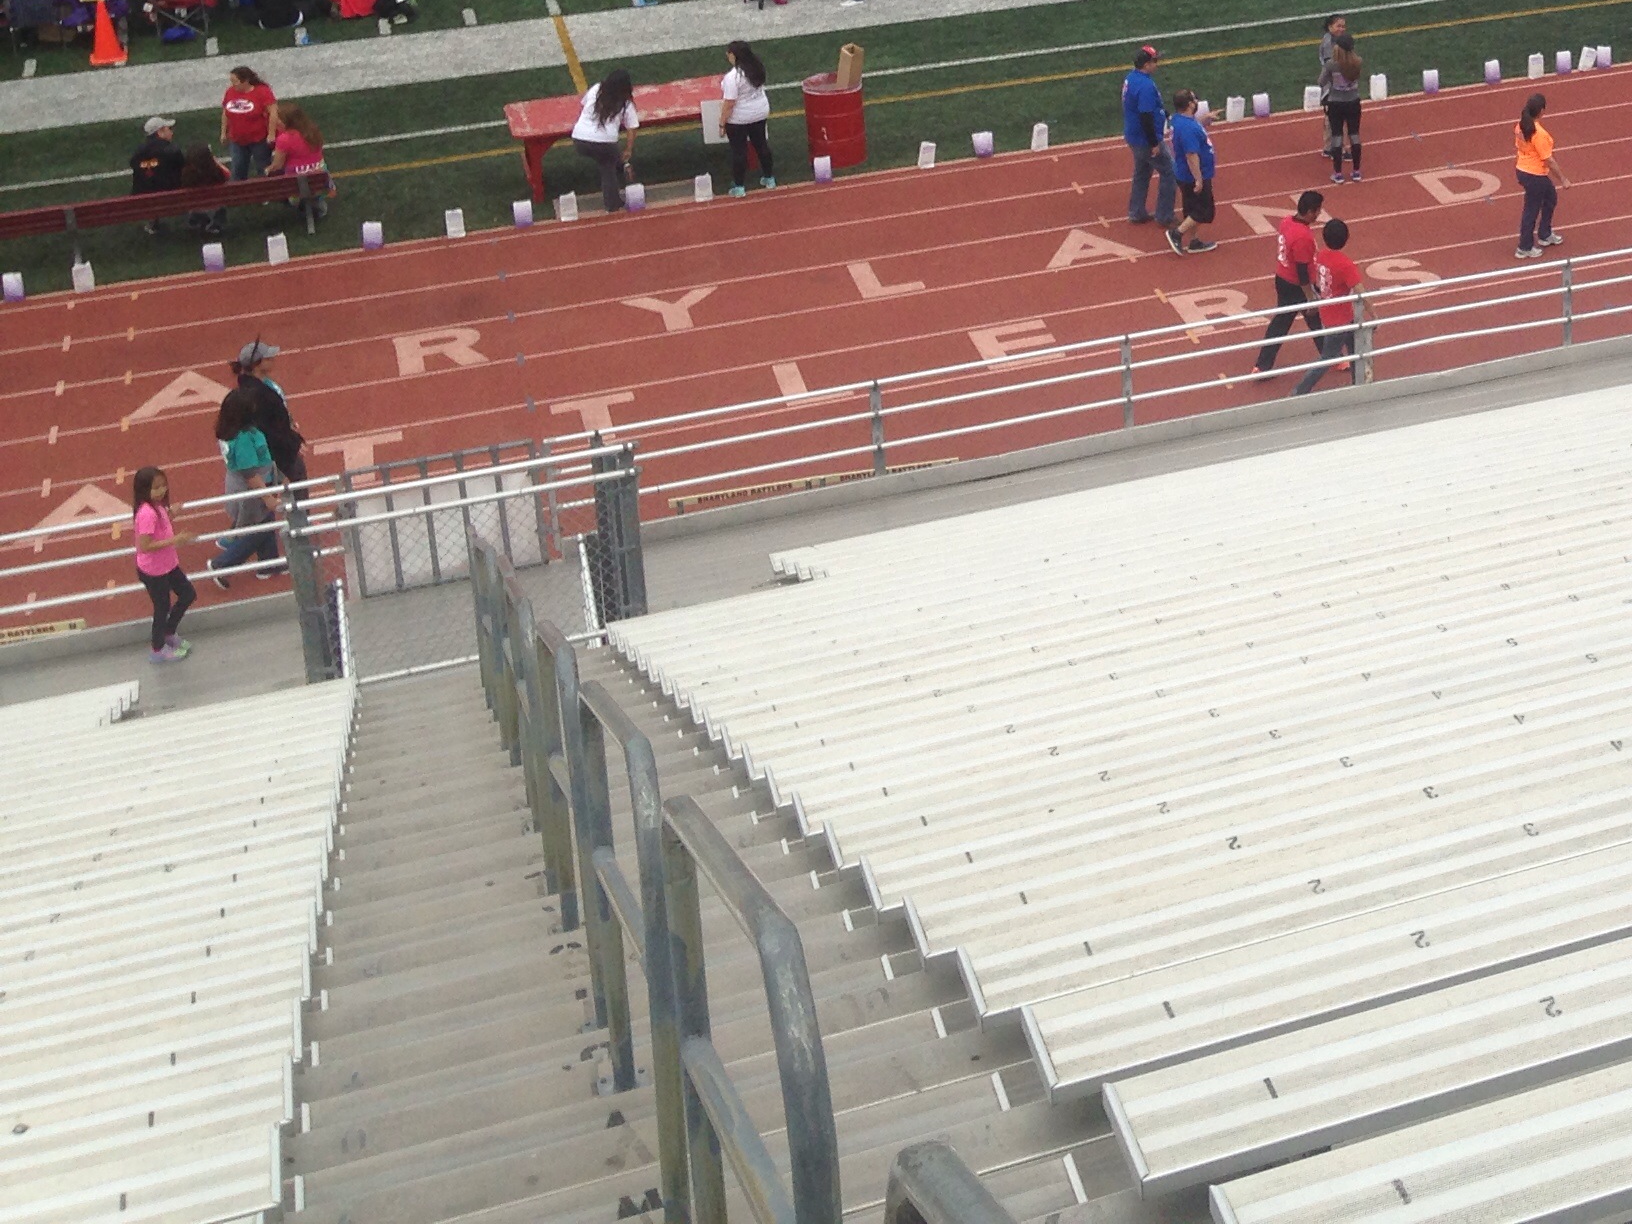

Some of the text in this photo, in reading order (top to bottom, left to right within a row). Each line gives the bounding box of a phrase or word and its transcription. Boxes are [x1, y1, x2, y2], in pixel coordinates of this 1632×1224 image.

[8, 625, 56, 637] RATTLERS
[998, 723, 1018, 735] 2
[1421, 785, 1440, 800] 3
[1225, 835, 1243, 851] 2
[1307, 878, 1327, 895] 2
[1409, 929, 1432, 949] 2
[1539, 995, 1563, 1018] 2
